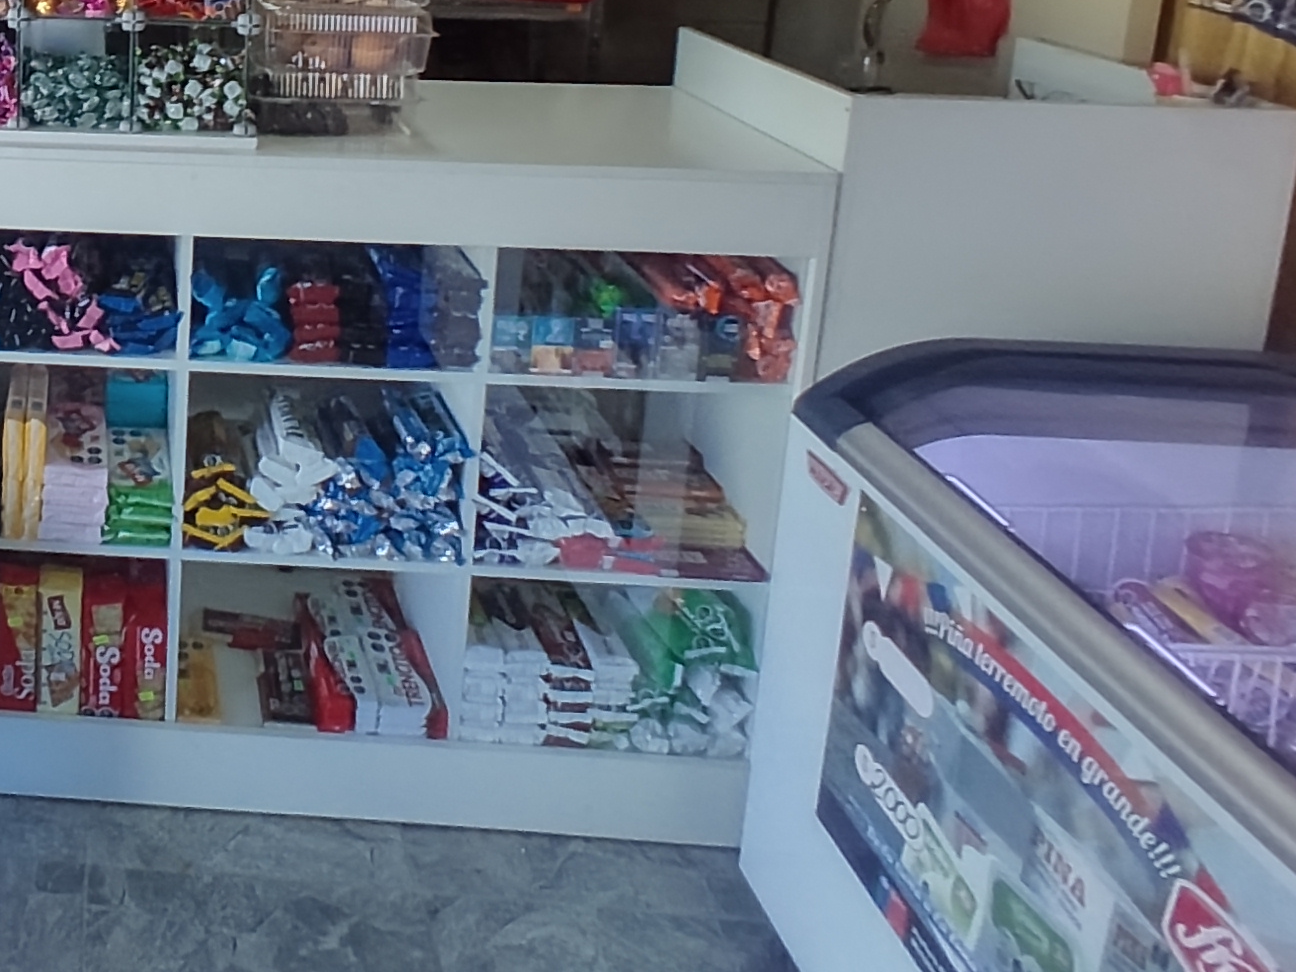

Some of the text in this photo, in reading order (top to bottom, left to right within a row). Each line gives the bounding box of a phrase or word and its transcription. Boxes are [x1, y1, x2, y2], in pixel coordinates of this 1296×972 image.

[14, 648, 36, 700] Soda
[95, 644, 121, 705] Soda
[140, 626, 164, 680] Soda
[974, 642, 1056, 733] terremoto
[1057, 728, 1083, 763] en
[1080, 755, 1182, 879] grande!!!
